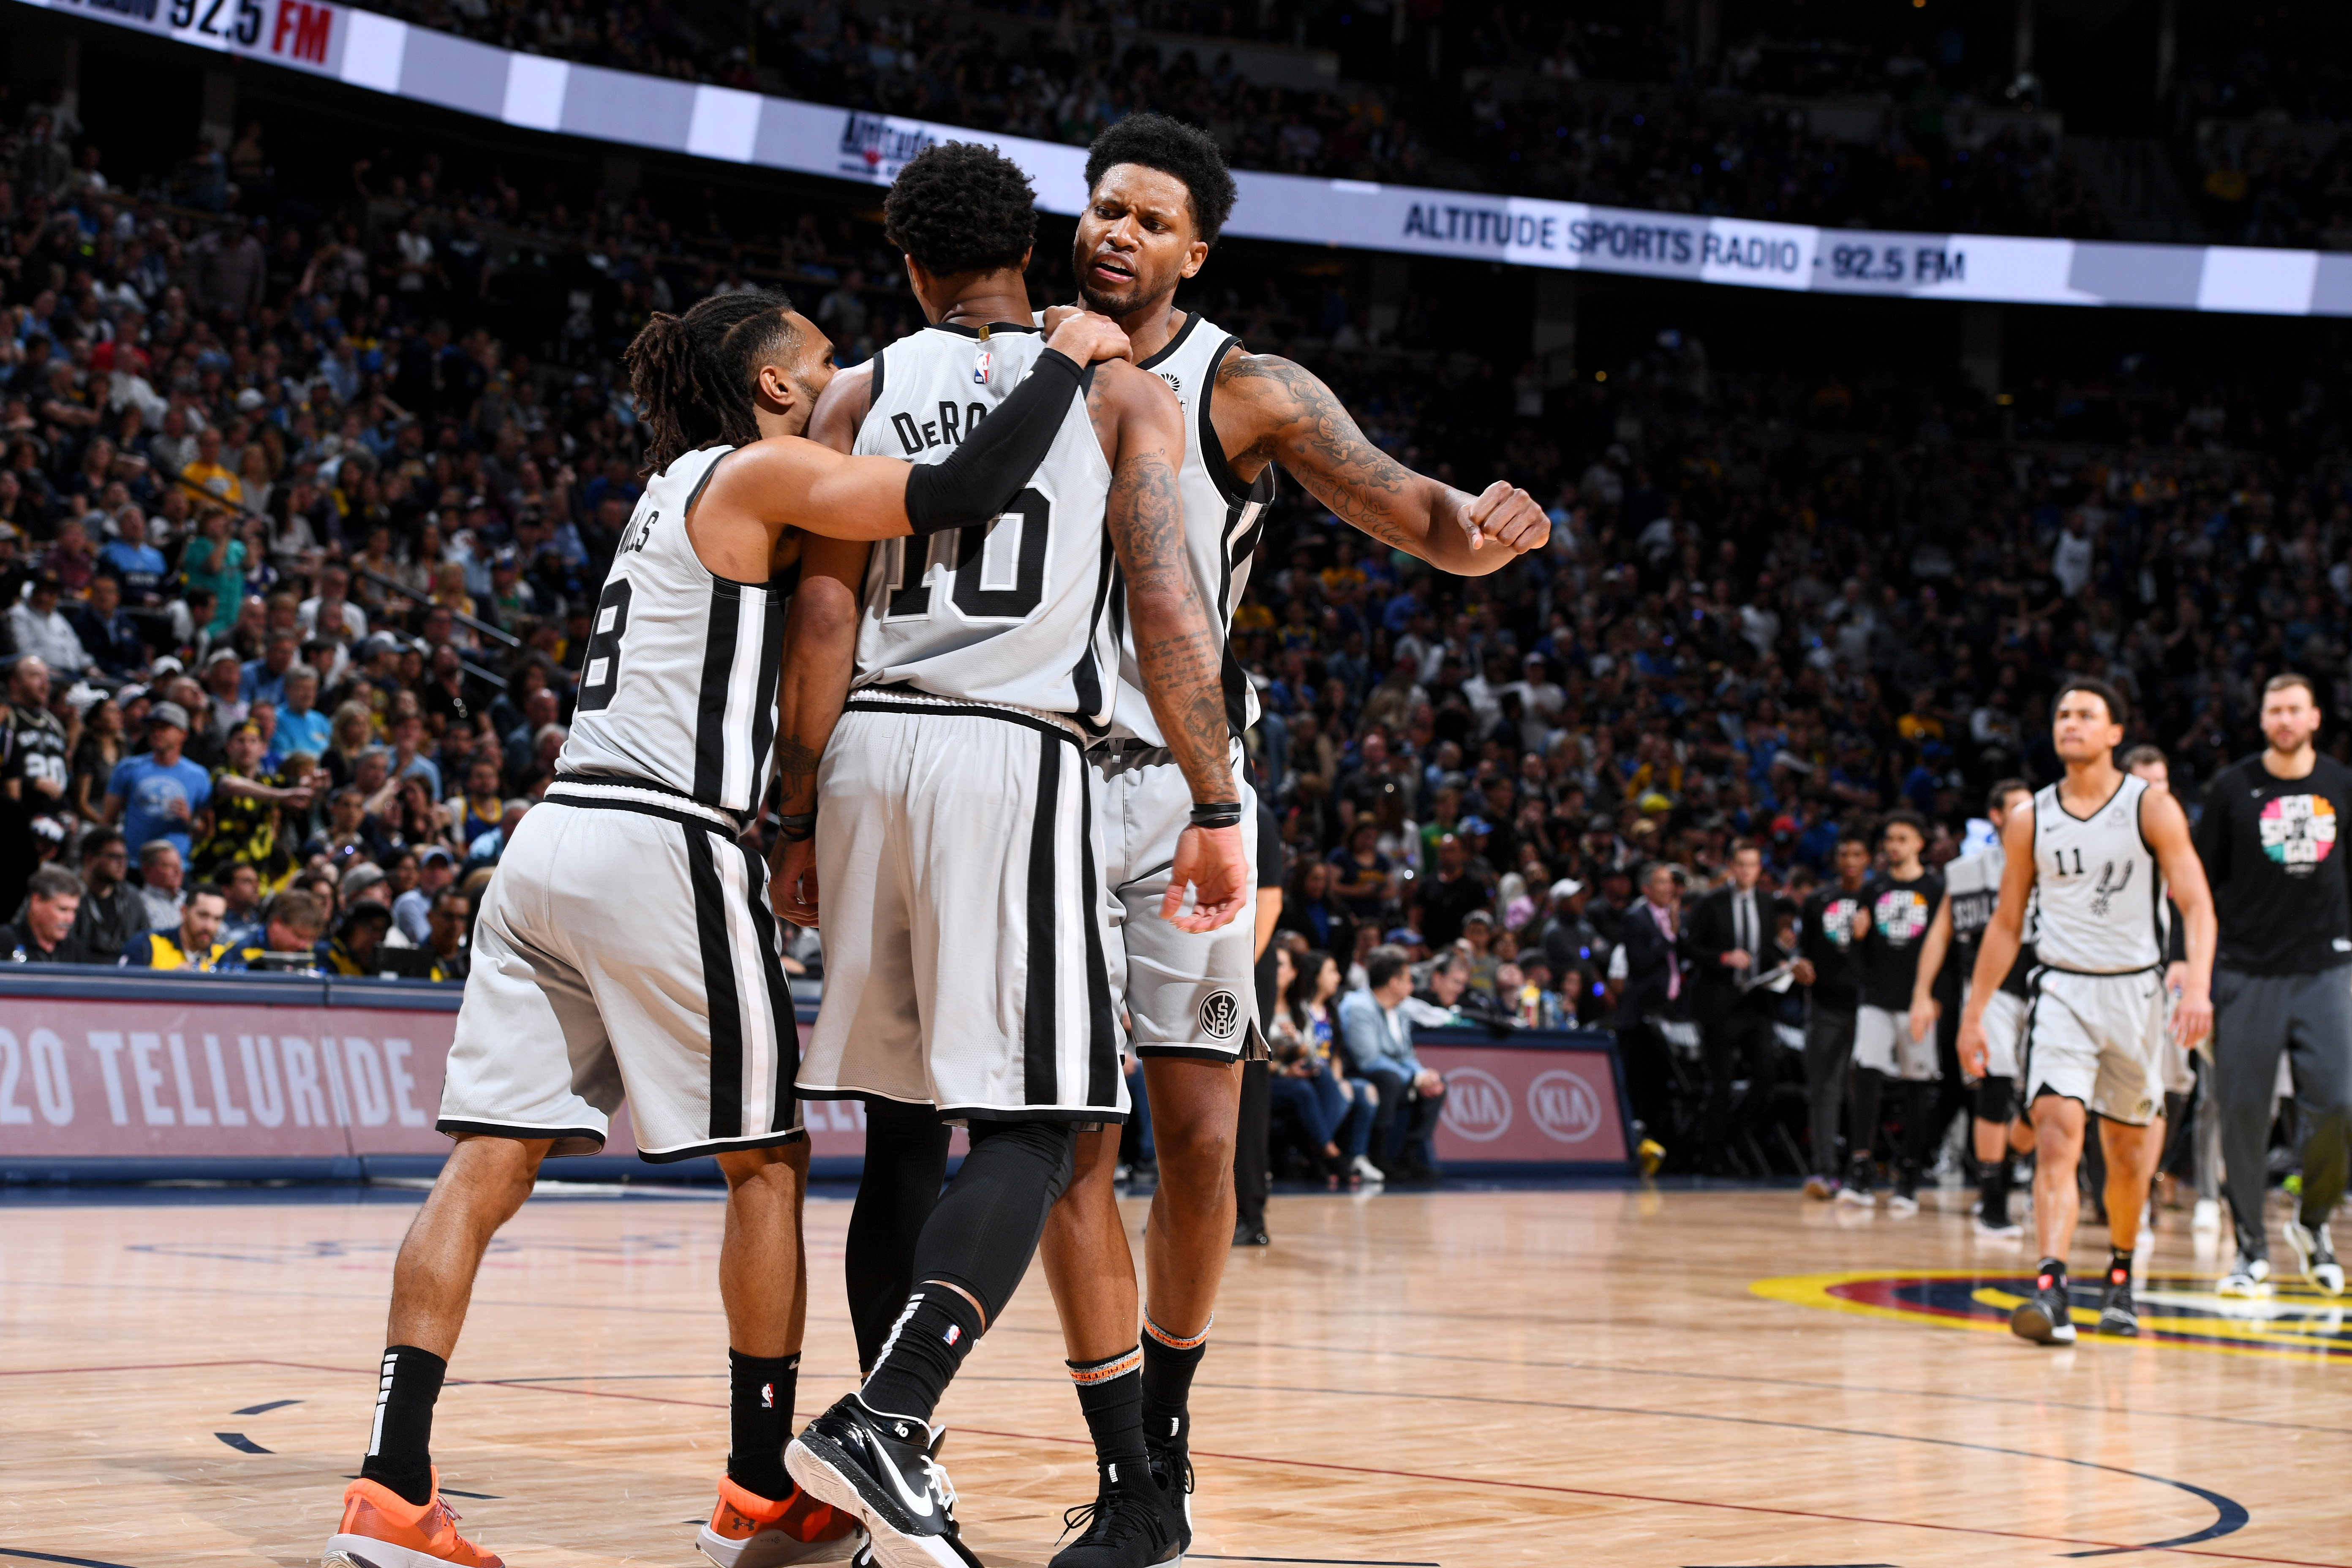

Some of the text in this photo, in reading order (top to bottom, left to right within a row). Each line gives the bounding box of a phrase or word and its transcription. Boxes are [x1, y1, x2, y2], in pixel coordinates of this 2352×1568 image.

[272, 0, 332, 64] FM
[1403, 203, 1557, 250] ALTITUDE
[1568, 218, 1693, 264] SPORTS
[1701, 233, 1799, 272] RADIO
[1831, 244, 1904, 281] 92.5
[1916, 248, 1967, 282] FM
[884, 481, 1056, 624] 10
[577, 571, 636, 718] 8
[2055, 847, 2085, 875] 11
[87, 1031, 428, 1128] TELLURIDE
[1448, 1083, 1503, 1125] KIA
[1540, 1086, 1593, 1127] KIA
[894, 1422, 909, 1437] 10
